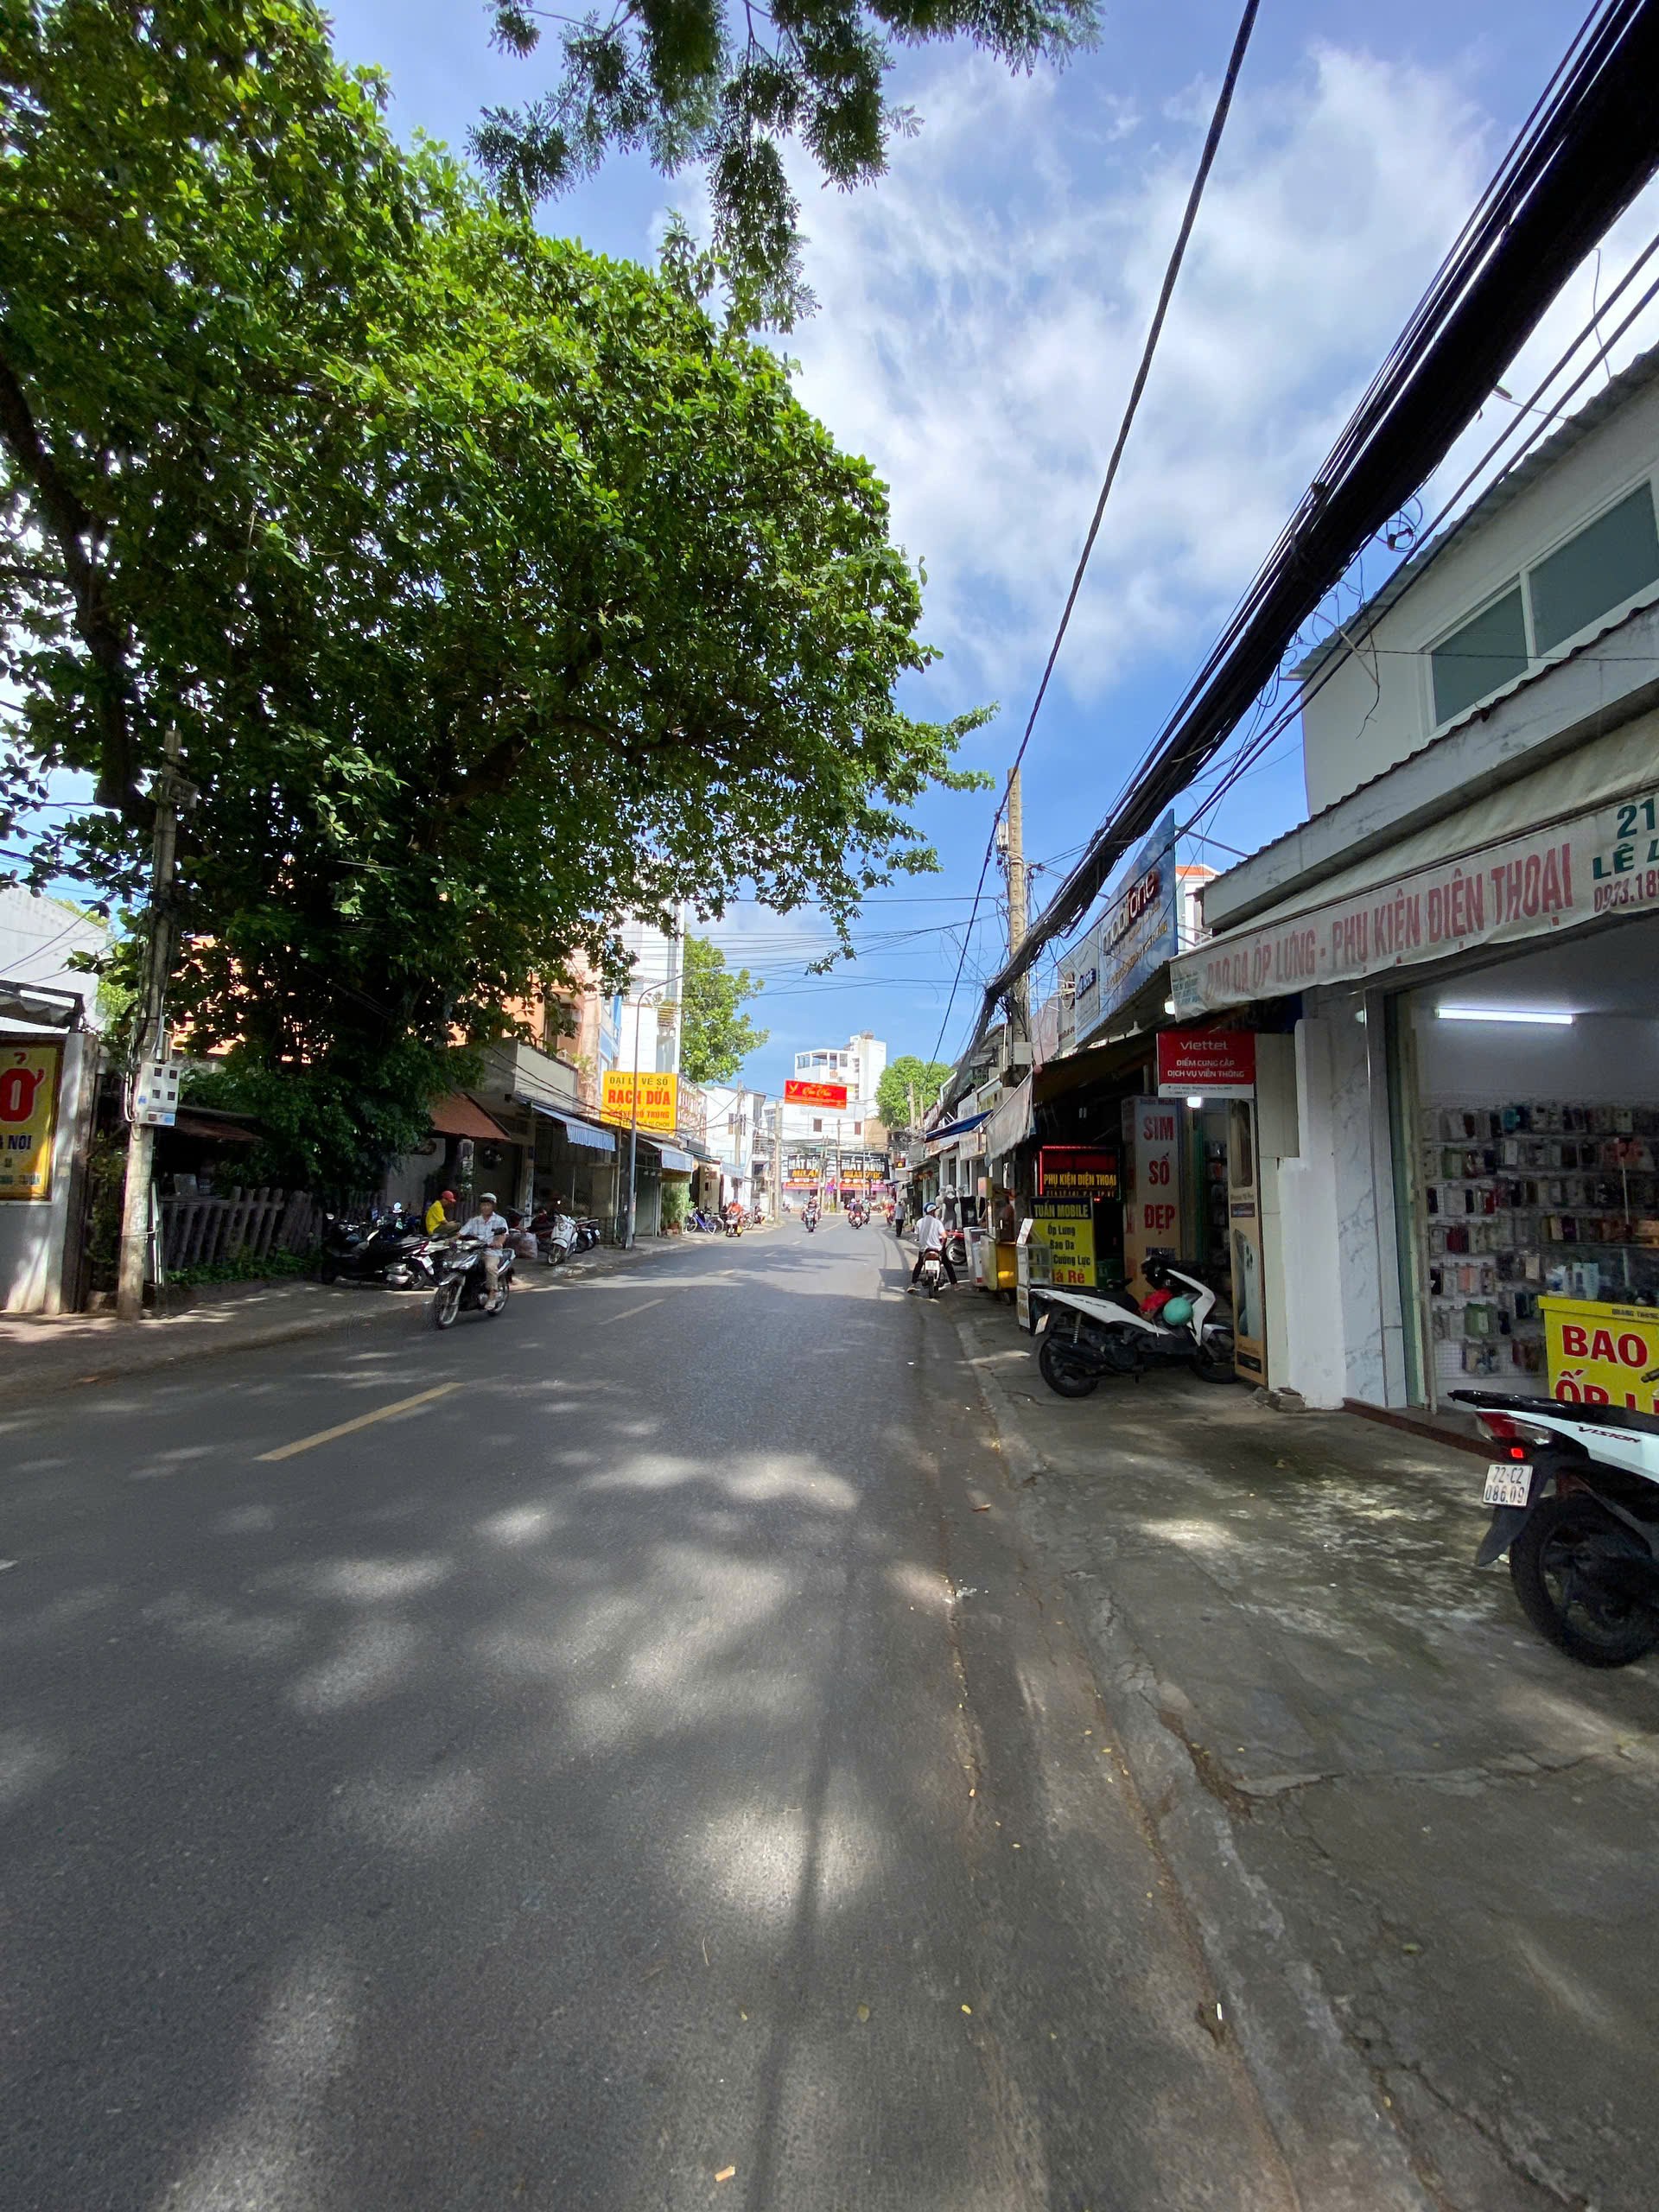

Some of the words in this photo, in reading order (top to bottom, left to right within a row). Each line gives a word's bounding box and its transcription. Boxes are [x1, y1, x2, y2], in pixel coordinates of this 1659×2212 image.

[1592, 843, 1635, 880] LÊ
[1332, 912, 1368, 973] PHỤ
[1375, 888, 1421, 964] KIỆN
[1427, 868, 1484, 950] ĐIỆN
[1491, 842, 1573, 926] THOẠI
[1180, 1041, 1228, 1051] viettel
[609, 1077, 625, 1086] ĐẠI
[641, 1075, 653, 1085] VÉ
[657, 1076, 670, 1085] SỐ
[1218, 1069, 1244, 1077] THÔNG
[608, 1089, 641, 1107] RẠCH
[1143, 1116, 1174, 1141] SIM
[8, 1133, 32, 1154] NỘI
[1148, 1152, 1170, 1185] SỐ
[1044, 1174, 1058, 1187] PHỤ
[1059, 1172, 1076, 1188] KIỆN
[1096, 1174, 1116, 1187] THOẠI
[1034, 1199, 1055, 1217] TUẤN
[1057, 1205, 1088, 1217] MOBILE
[1144, 1204, 1176, 1235] ĐẸP
[1050, 1239, 1064, 1249] Bao
[1065, 1239, 1075, 1249] Da
[1077, 1255, 1090, 1268] Lực
[1068, 1268, 1085, 1284] Rẻ
[1562, 1325, 1648, 1368] BAO
[1578, 1426, 1641, 1443] VISION
